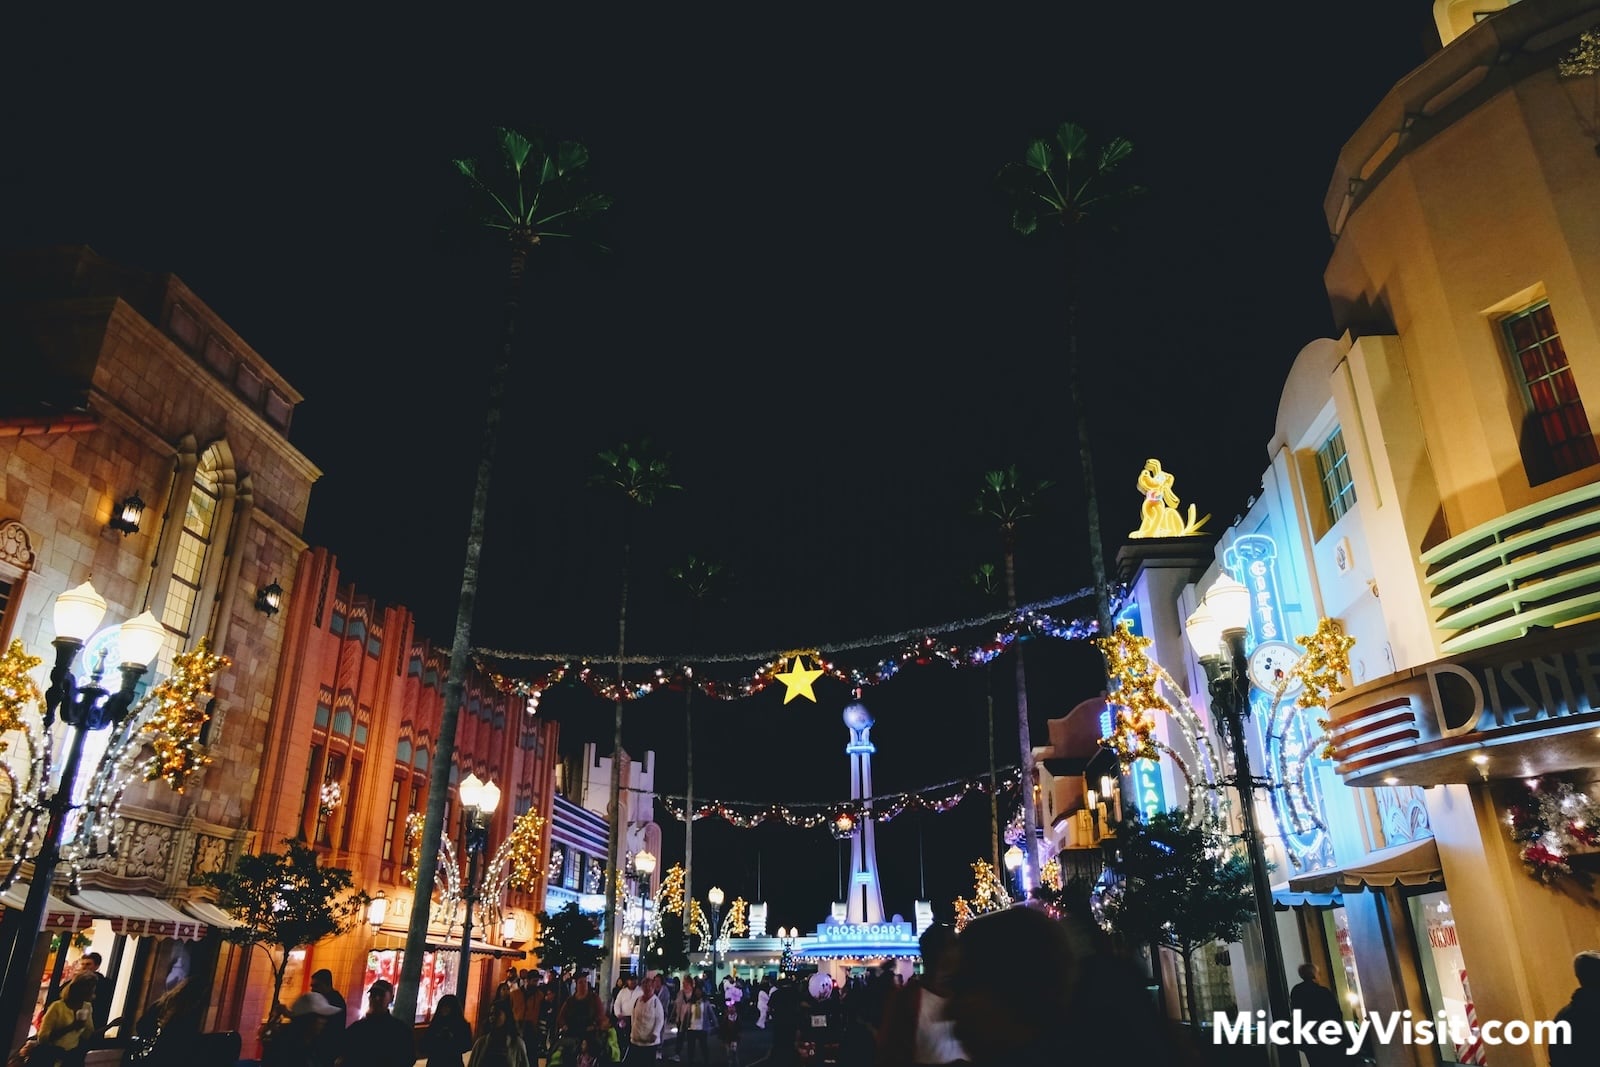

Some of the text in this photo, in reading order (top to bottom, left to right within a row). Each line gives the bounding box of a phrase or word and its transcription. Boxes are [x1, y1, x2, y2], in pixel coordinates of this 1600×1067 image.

[1249, 560, 1277, 639] GIFTS
[826, 925, 901, 936] CROSSROADS
[1428, 926, 1457, 948] SEASON
